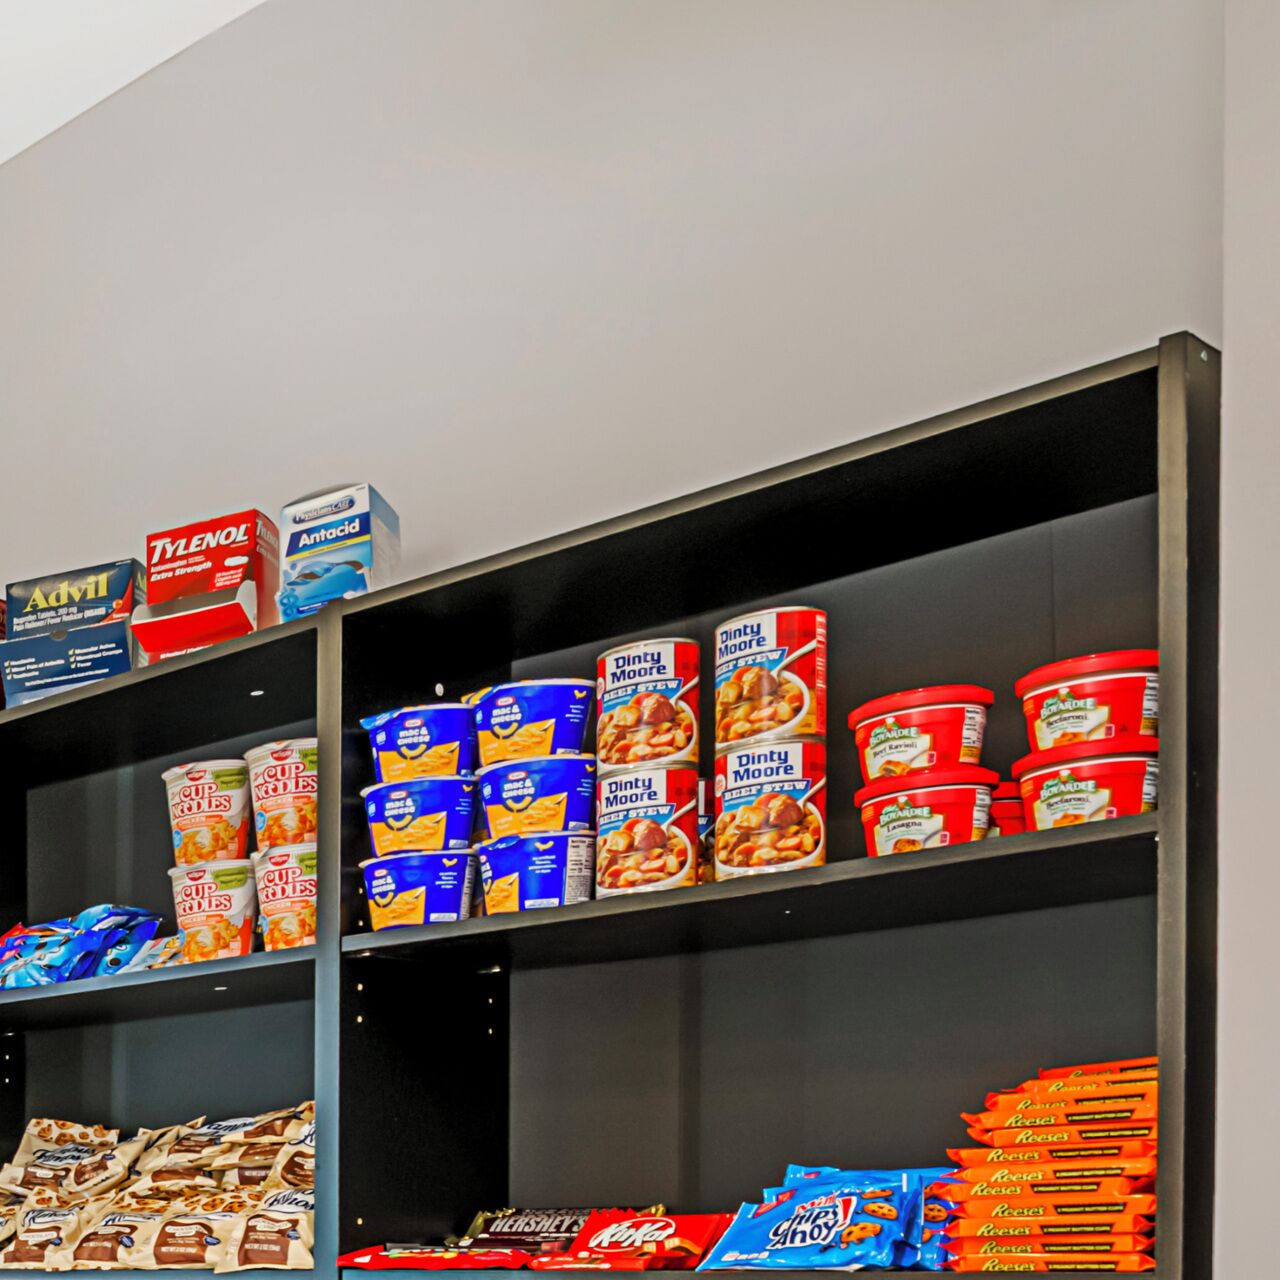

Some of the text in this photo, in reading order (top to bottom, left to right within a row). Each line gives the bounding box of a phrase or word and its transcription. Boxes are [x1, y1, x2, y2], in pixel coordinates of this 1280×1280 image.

[299, 518, 360, 548] Antacid
[150, 523, 249, 565] TYLENOL
[174, 561, 213, 577] Strength
[22, 571, 109, 613] Advil
[720, 622, 762, 644] Dinty
[718, 636, 767, 660] Moore
[744, 649, 786, 666] STEW
[615, 651, 661, 670] Dinty
[610, 663, 667, 685] Moore
[642, 679, 681, 694] STEW
[1041, 698, 1096, 720] BOYARDEE
[869, 725, 919, 746] BOYARDEE
[737, 749, 789, 768] Dinty
[263, 762, 306, 783] CUP
[733, 763, 794, 783] Moore
[179, 783, 218, 800] CUP
[255, 775, 318, 801] NOODLES
[608, 776, 653, 794] Dinty
[761, 778, 809, 793] STEW
[1041, 780, 1097, 801] BOYARDEE
[171, 795, 232, 819] NOODLES
[605, 789, 658, 809] Moore
[631, 805, 672, 819] STEW
[880, 806, 931, 825] BOYARDEE
[886, 819, 923, 833] Lasagna
[263, 866, 303, 887] CUP
[181, 882, 218, 900] CUP
[1005, 1113, 1056, 1128] Reese's
[1015, 1129, 1070, 1144] Reese's
[987, 1148, 1040, 1163] Reese's
[991, 1168, 1043, 1183] Reese's
[970, 1182, 1021, 1196] Reese's
[992, 1203, 1045, 1217] Reese's
[490, 1214, 585, 1234] HERSHEY'S
[772, 1207, 838, 1238] Chips
[976, 1223, 1031, 1237] Reese's
[589, 1219, 675, 1249] KitKat
[980, 1240, 1032, 1254] Reese's
[981, 1258, 1035, 1272] Reese's
